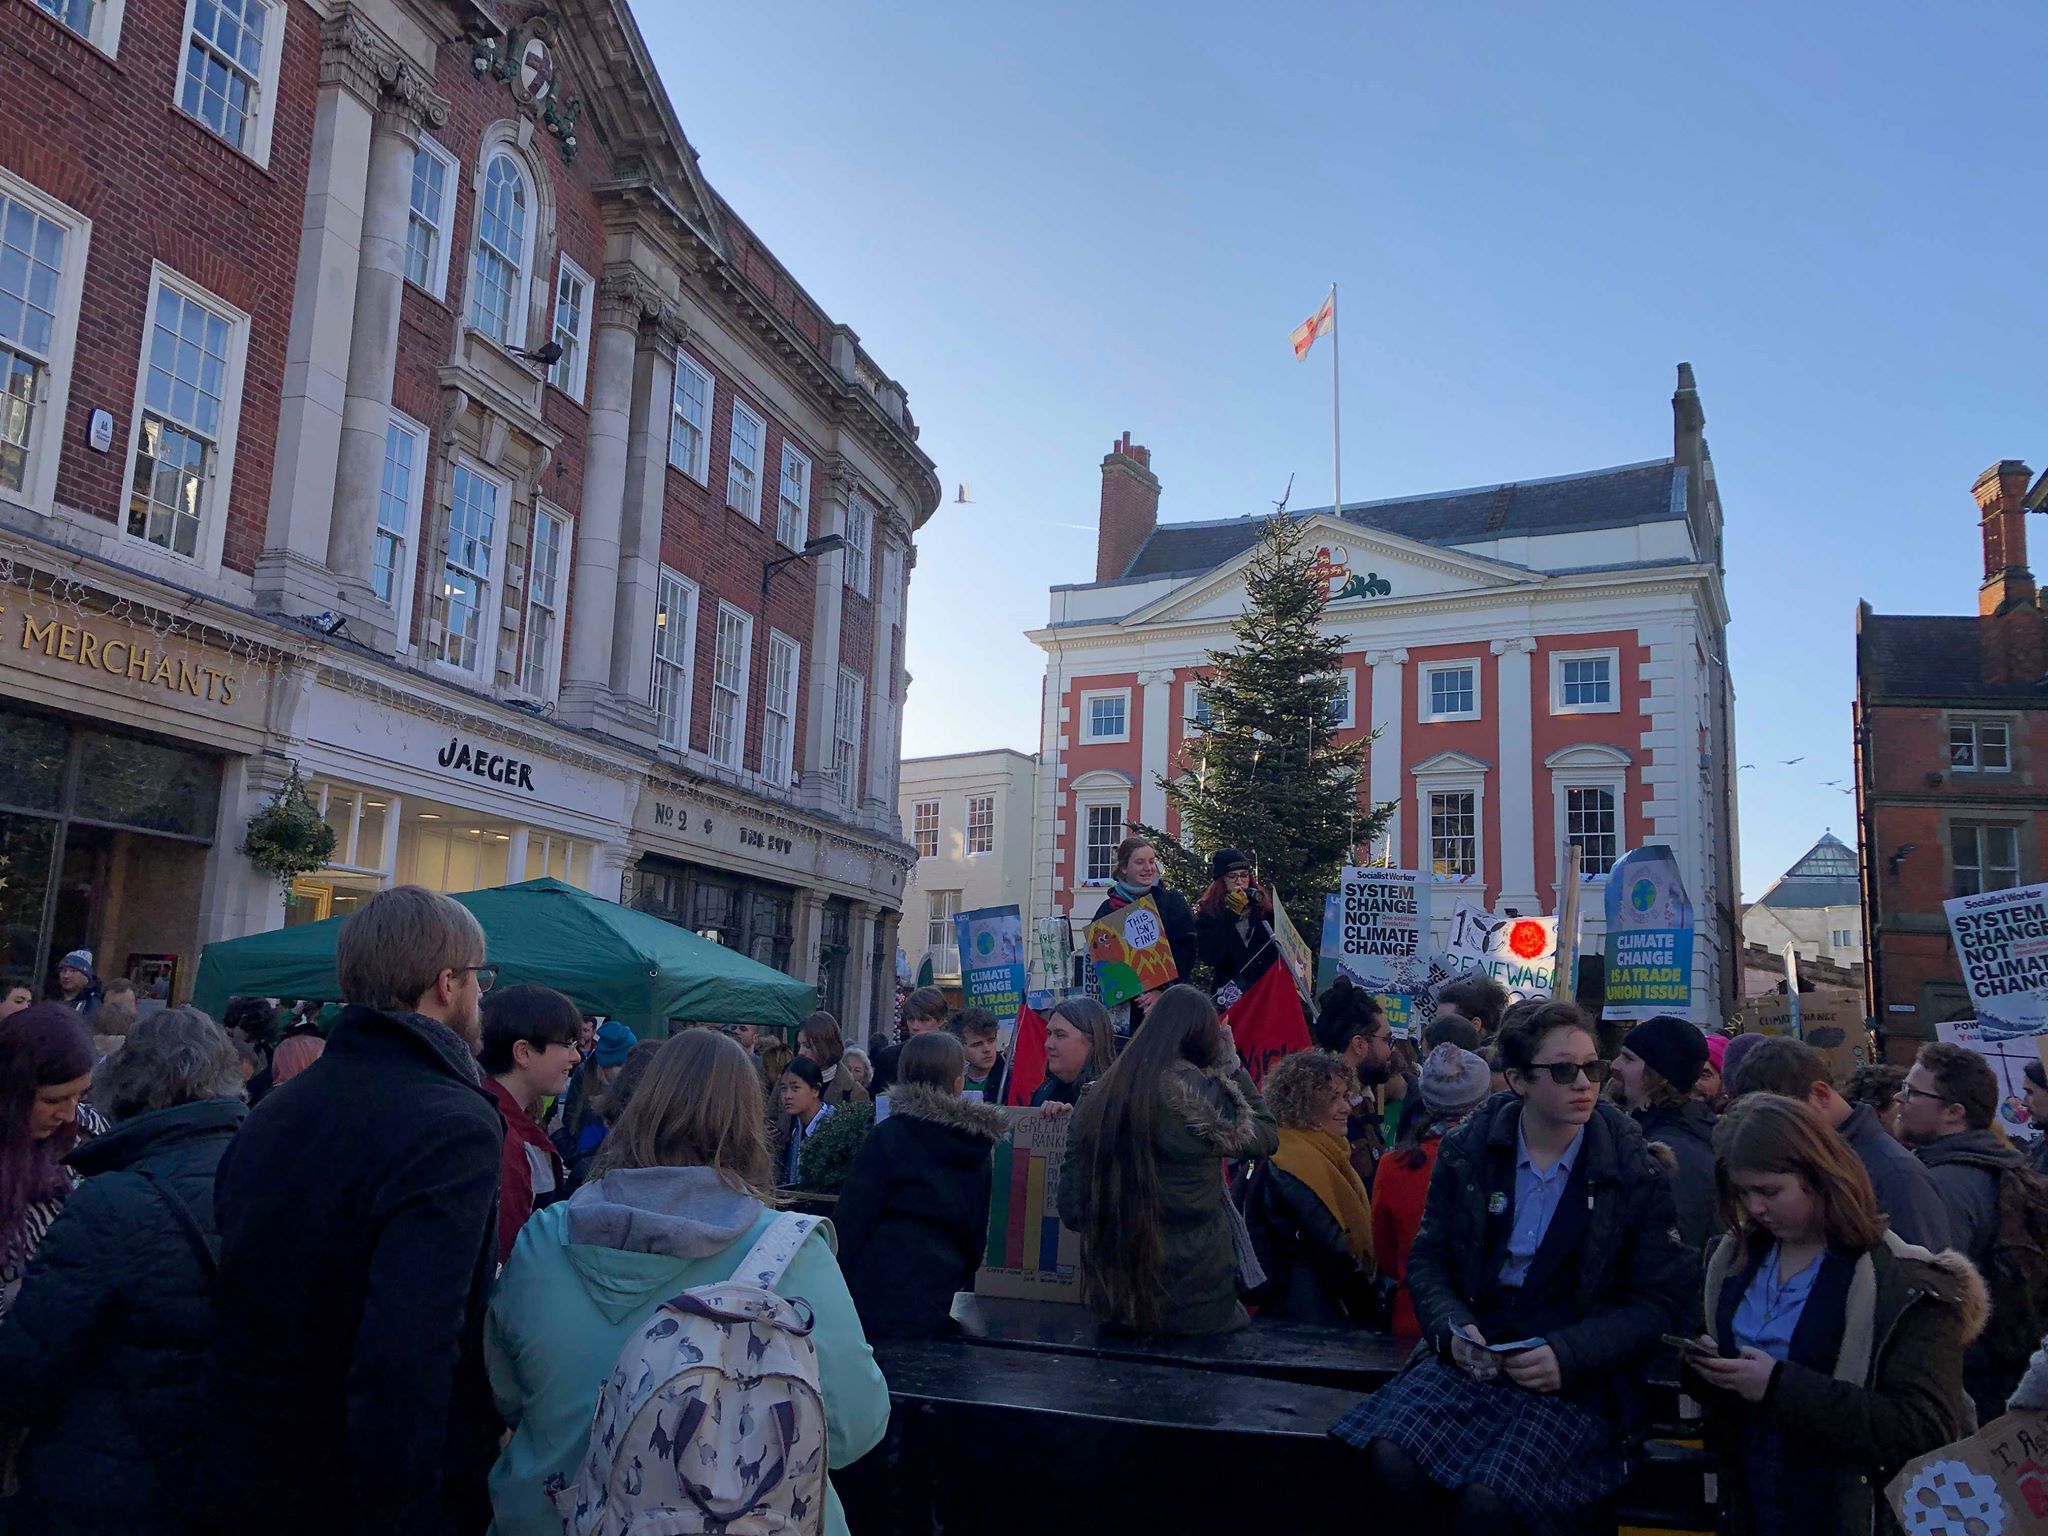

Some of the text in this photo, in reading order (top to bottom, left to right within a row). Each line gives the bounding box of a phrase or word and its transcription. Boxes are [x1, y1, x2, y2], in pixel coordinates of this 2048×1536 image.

[22, 613, 237, 705] MERCHANTS
[437, 737, 535, 792] JAEGER
[1357, 871, 1416, 882] Socialist Worker
[1345, 883, 1414, 899] SYSTEM
[1345, 897, 1417, 914] CHANGE
[1964, 890, 2042, 910] Socialist Worker
[1127, 913, 1149, 928] THIS
[1345, 912, 1379, 926] NOT
[1955, 903, 2047, 932] SYSTEM
[1136, 920, 1156, 936] ISN'T
[1344, 925, 1418, 943] CLIMATE
[1134, 934, 1157, 948] FINE
[1344, 940, 1416, 957] CHANGE
[1617, 934, 1674, 950] CLIMATE
[1616, 951, 1673, 966] CHANGE
[1964, 943, 2009, 966] NOT
[1612, 968, 1681, 982] IS A TRADE
[1970, 953, 2048, 981] CLIMAT
[970, 968, 1011, 983] CLIMATE
[1085, 974, 1098, 985] NO
[972, 980, 1012, 995] CHANGE
[1606, 985, 1688, 1001] UNION ISSUE
[1974, 972, 2048, 998] CHANG
[985, 992, 1019, 1005] TRADE
[994, 1004, 1019, 1015] ISSU
[1759, 1014, 1792, 1026] CLIMAT
[1954, 1022, 1979, 1031] POW
[1017, 1115, 1067, 1133] GREENP
[1032, 1133, 1065, 1148] RANKI
